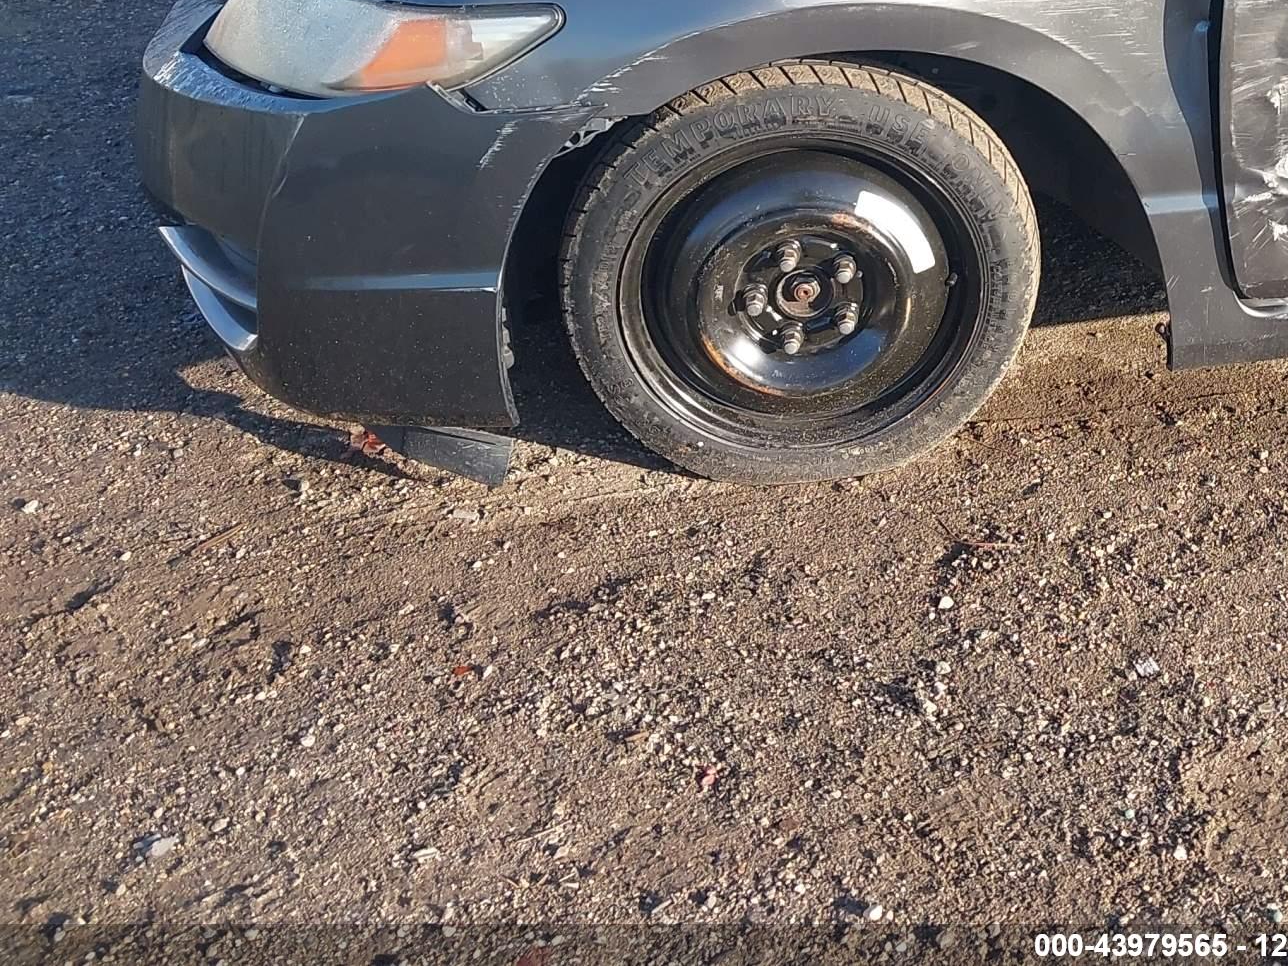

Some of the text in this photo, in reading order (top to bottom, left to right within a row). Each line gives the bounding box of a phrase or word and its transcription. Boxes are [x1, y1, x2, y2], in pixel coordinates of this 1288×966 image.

[622, 95, 1010, 220] TEMPORARY USE ONLY
